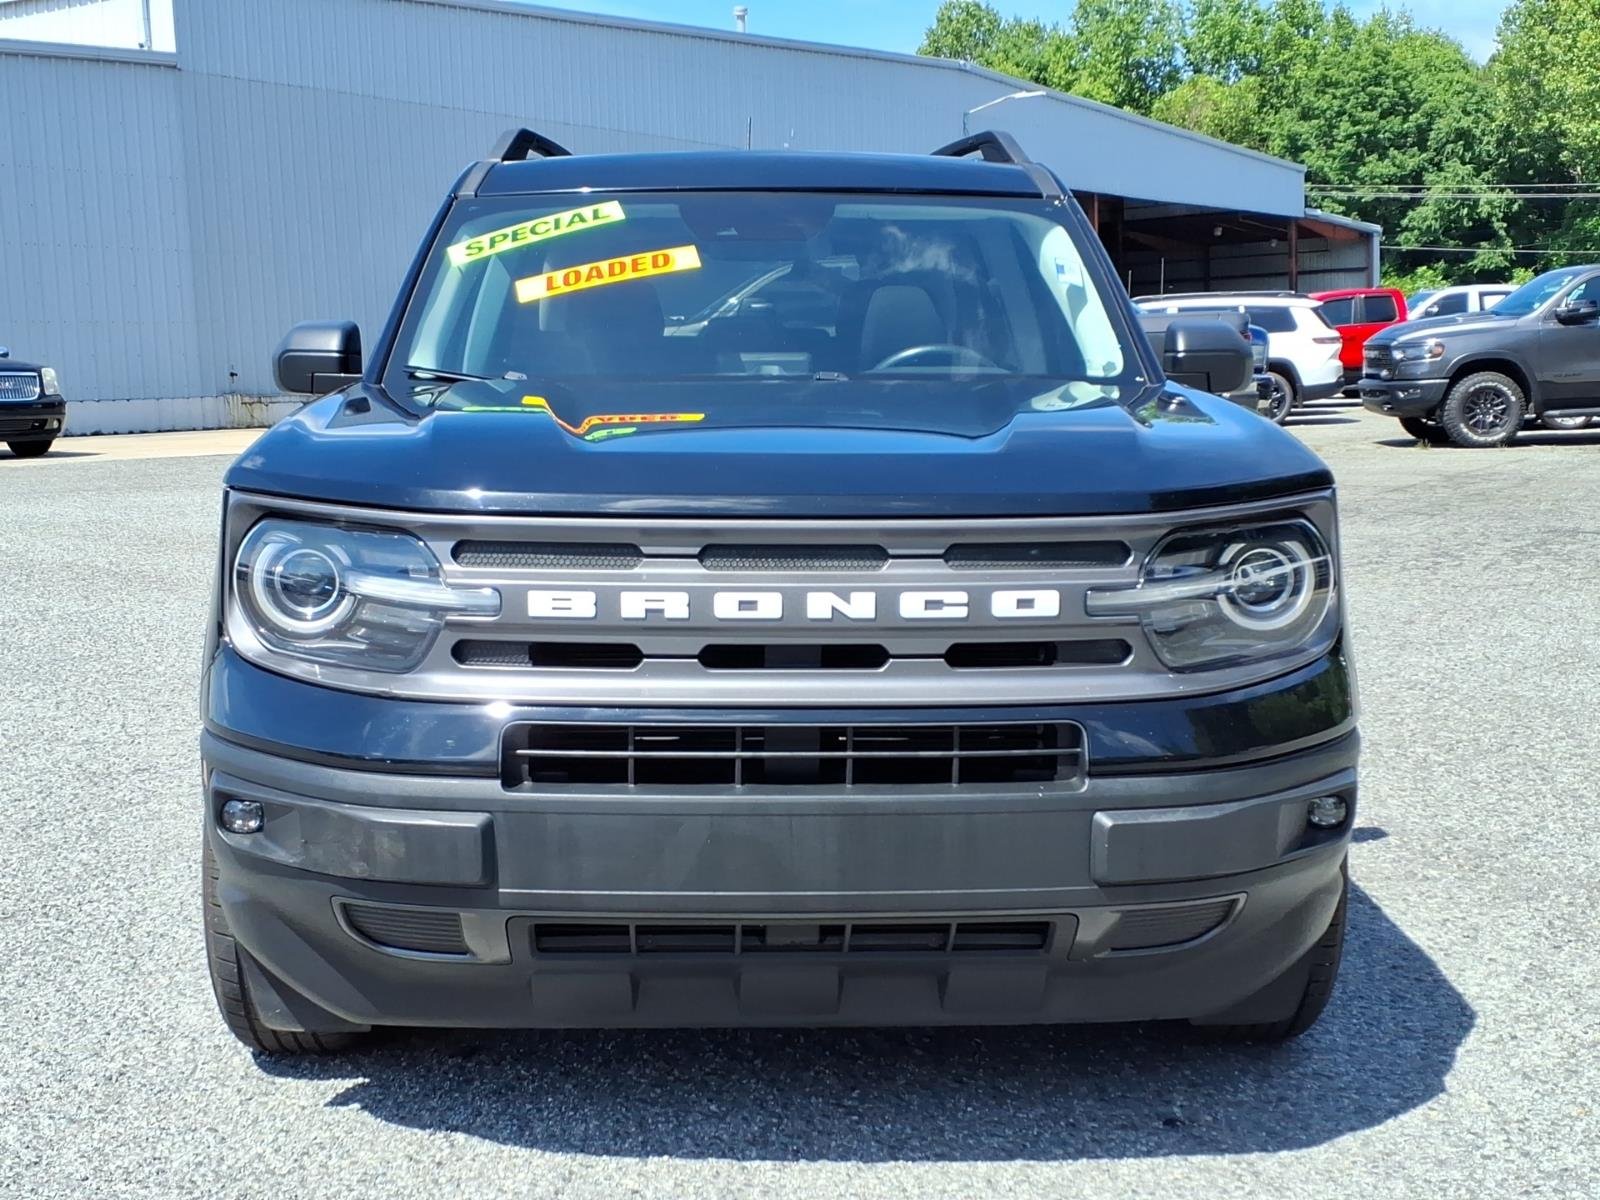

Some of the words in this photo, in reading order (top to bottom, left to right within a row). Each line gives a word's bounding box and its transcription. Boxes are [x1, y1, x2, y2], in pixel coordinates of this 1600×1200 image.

[465, 208, 611, 257] SPECIAL
[546, 253, 671, 292] LOADED
[527, 589, 1060, 620] BRONCO
